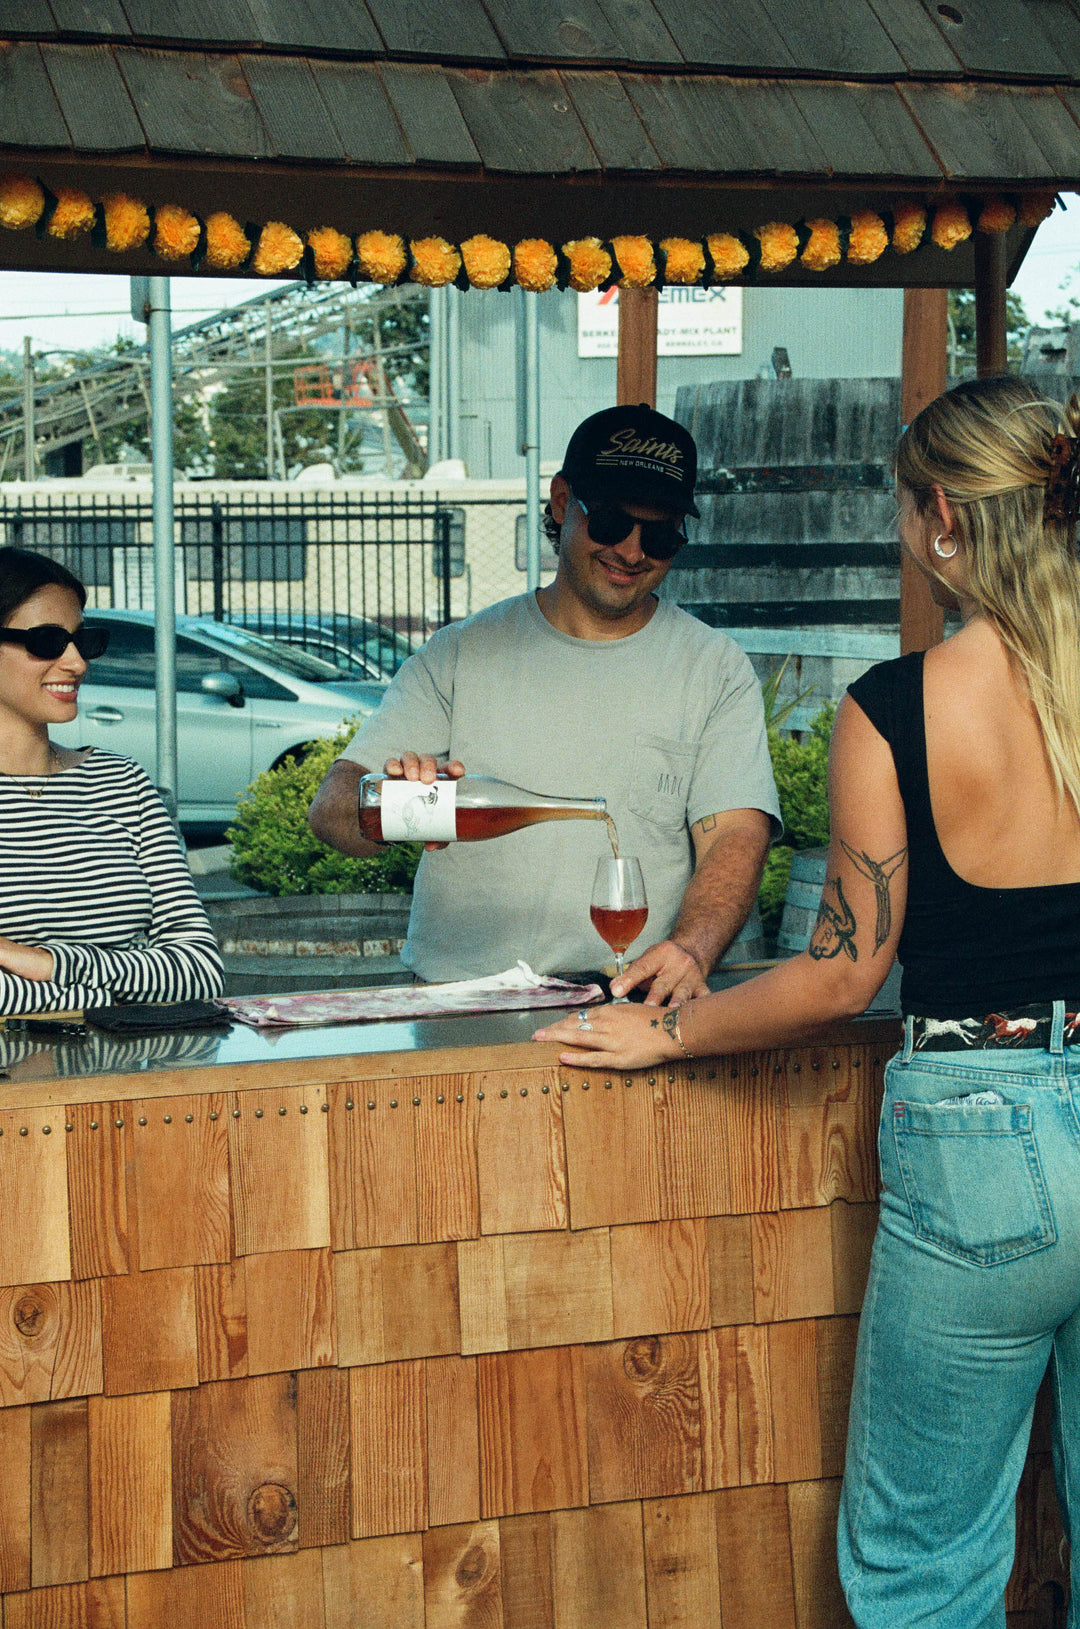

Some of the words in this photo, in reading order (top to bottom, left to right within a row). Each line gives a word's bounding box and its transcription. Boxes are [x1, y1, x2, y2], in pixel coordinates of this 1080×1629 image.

[657, 287, 727, 303] EMEX
[703, 326, 738, 335] PLANT
[601, 428, 684, 464] Saints
[635, 460, 664, 473] ORLEANS
